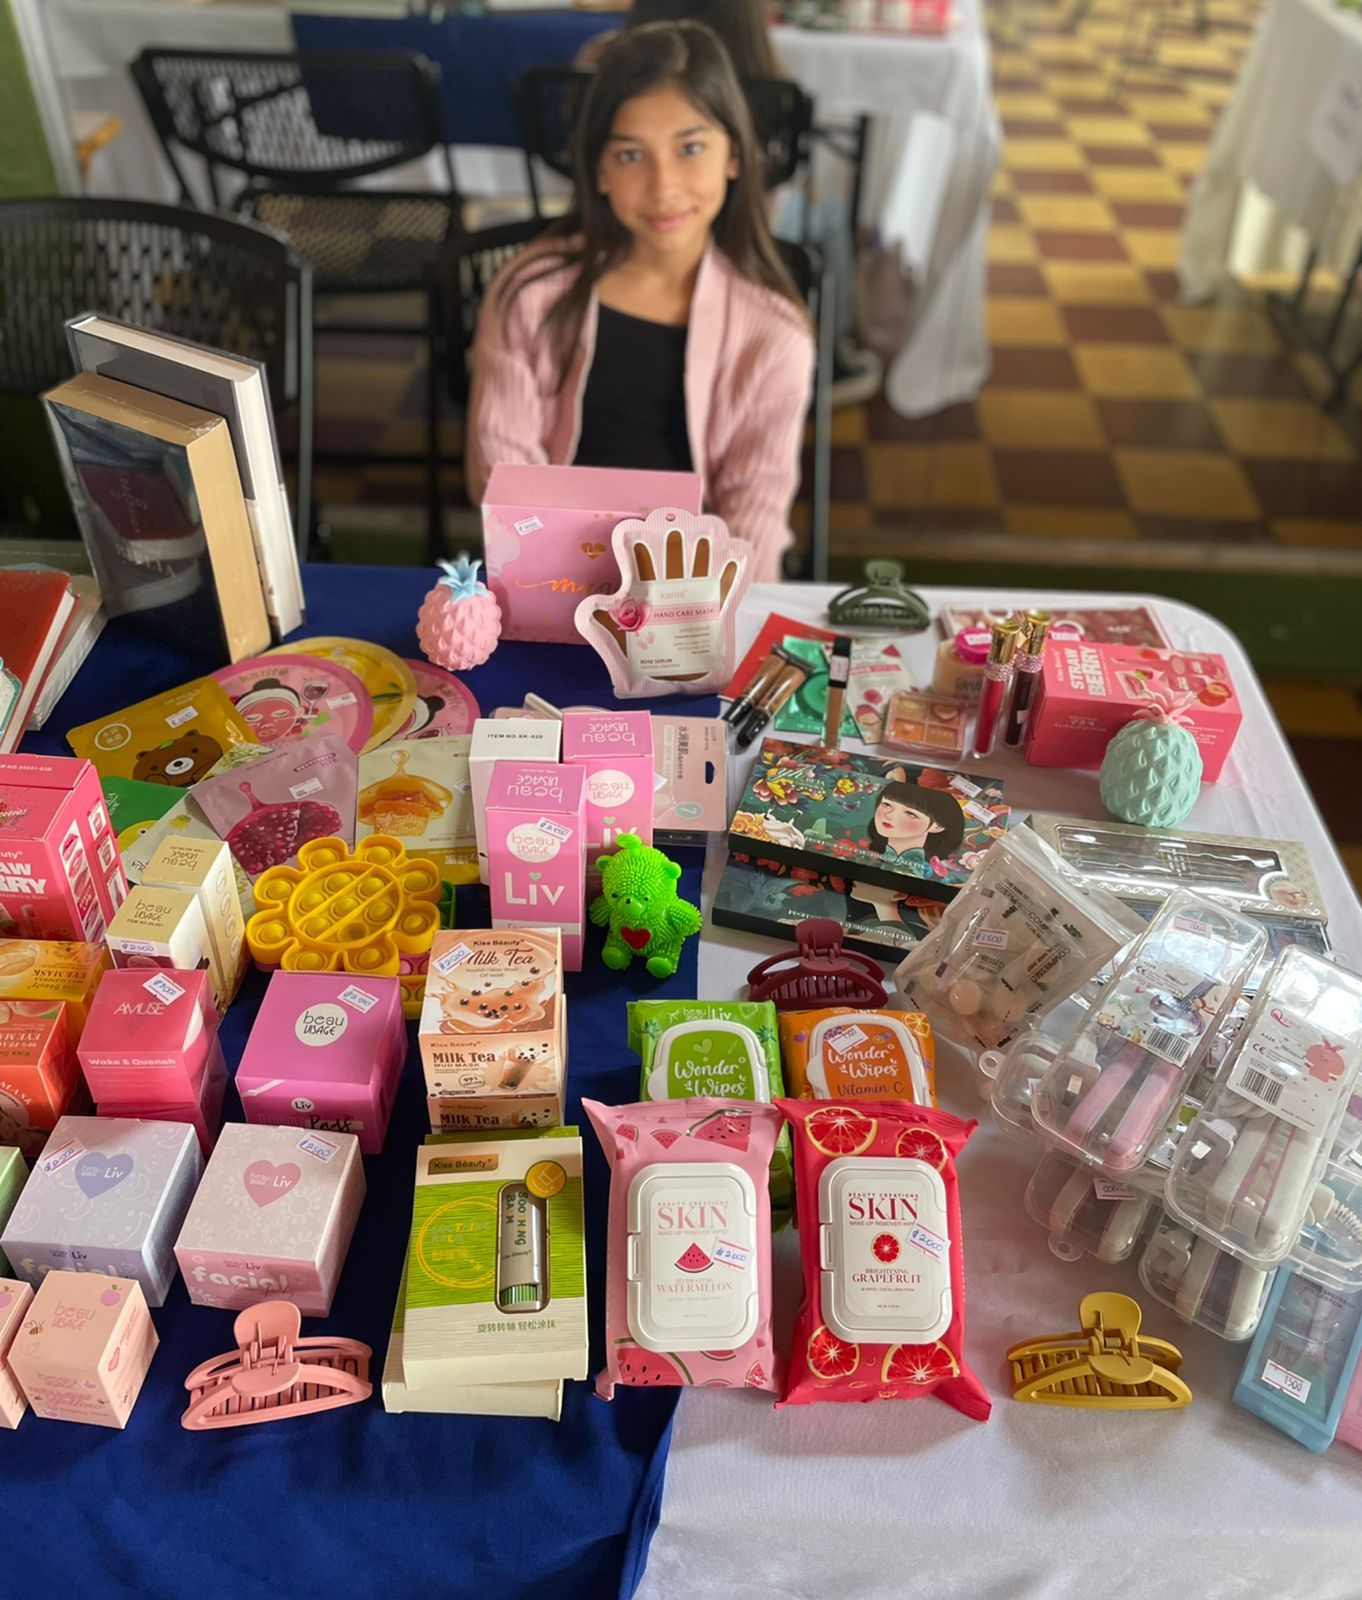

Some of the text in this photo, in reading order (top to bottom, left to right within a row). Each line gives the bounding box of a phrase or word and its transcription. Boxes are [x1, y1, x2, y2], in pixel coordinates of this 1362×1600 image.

[654, 607, 714, 619] HAND CARE MASK
[1063, 647, 1086, 690] STRAW
[1078, 644, 1107, 698] BERRY
[581, 732, 637, 746] beau
[588, 776, 630, 791] beau
[506, 784, 565, 804] beau
[511, 831, 555, 846] beau
[161, 857, 199, 871] beau
[504, 872, 565, 905] Liv
[134, 899, 173, 915] beau
[504, 948, 536, 967] Tea
[33, 969, 63, 979] MASK
[113, 1001, 166, 1015] AMUSE
[303, 1011, 344, 1027] beau
[432, 1052, 497, 1064] Milk Tea
[828, 1045, 889, 1062] Wonder
[88, 1058, 120, 1067] Wake
[674, 1057, 740, 1079] Wonder
[848, 1062, 899, 1079] Wipes
[693, 1079, 747, 1098] Wipes
[836, 1080, 905, 1097] Vitamin C
[294, 1101, 312, 1111] Liv
[440, 1113, 500, 1126] Milk Tea
[433, 1160, 453, 1170] Kiss
[104, 1166, 124, 1180] Liv
[272, 1175, 293, 1188] Liv
[848, 1197, 918, 1221] SKIN
[657, 1205, 729, 1230] SKIN
[72, 1250, 88, 1261] Liv
[244, 1261, 262, 1271] Liv
[852, 1273, 922, 1284] GRAPEFRUIT
[656, 1282, 733, 1293] WATERMELON
[54, 1300, 96, 1320] beau
[1283, 1375, 1303, 1392] 1500
